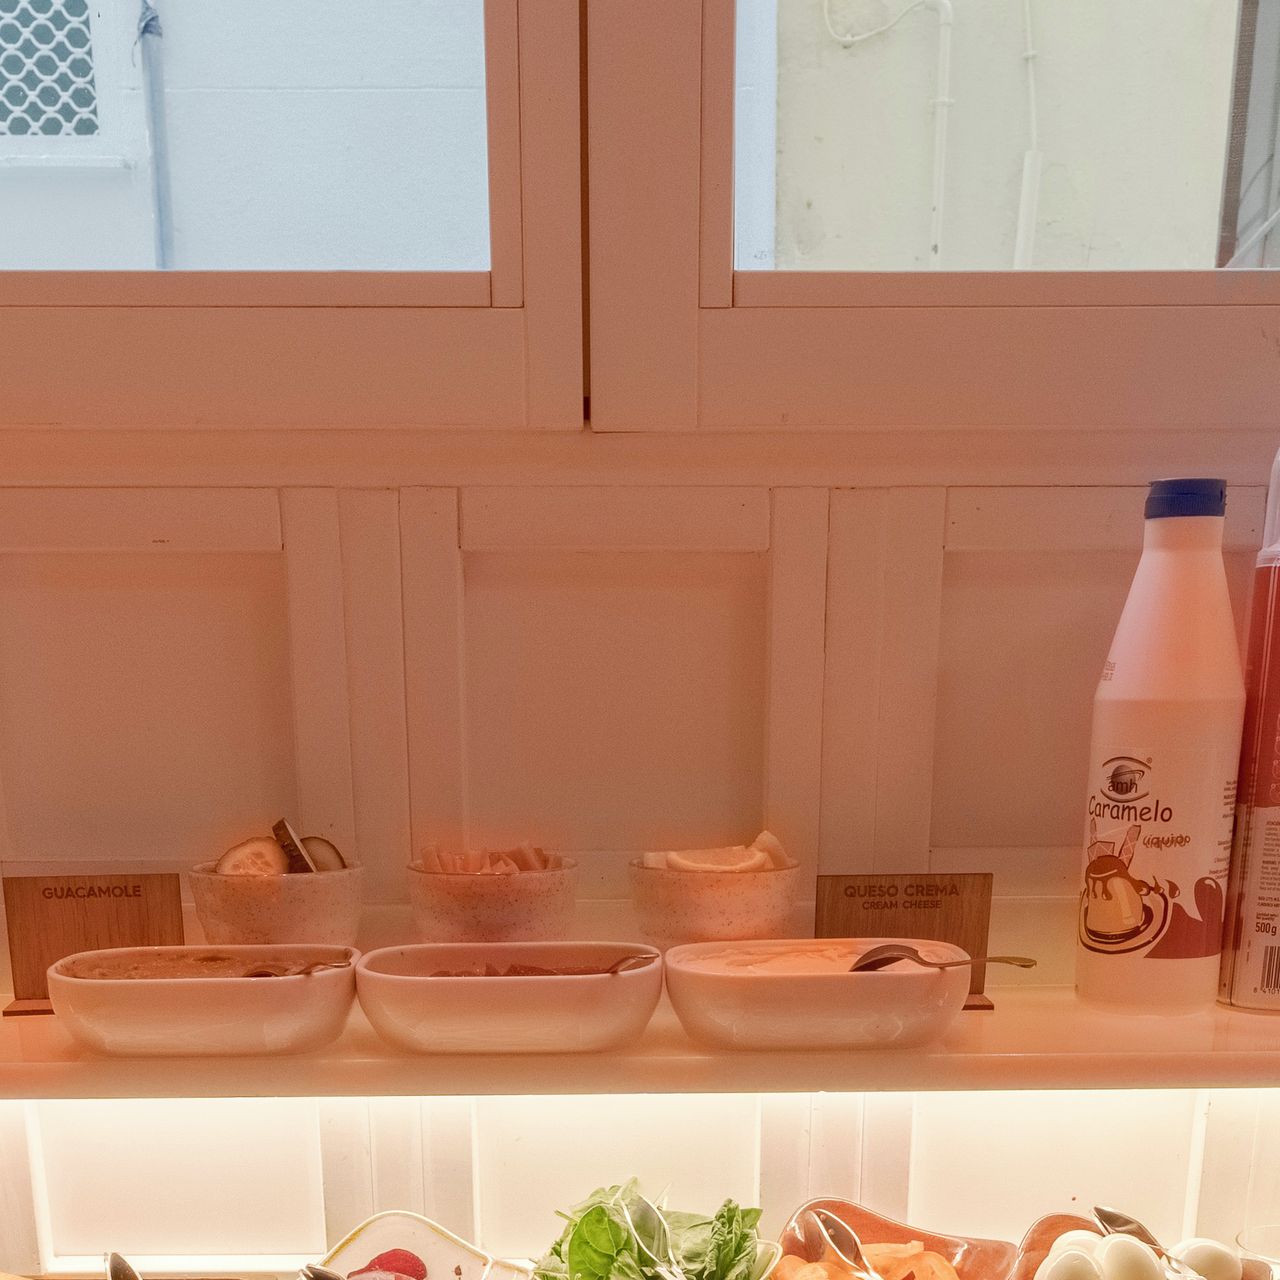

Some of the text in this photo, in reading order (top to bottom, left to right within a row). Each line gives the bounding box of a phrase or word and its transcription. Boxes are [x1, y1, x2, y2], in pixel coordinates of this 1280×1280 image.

[1107, 779, 1138, 793] amh
[1088, 796, 1173, 822] Caramelo
[41, 885, 142, 900] GUACAMOLE
[844, 884, 960, 898] QUESO CREMA
[862, 900, 943, 910] CREAM CHEESE
